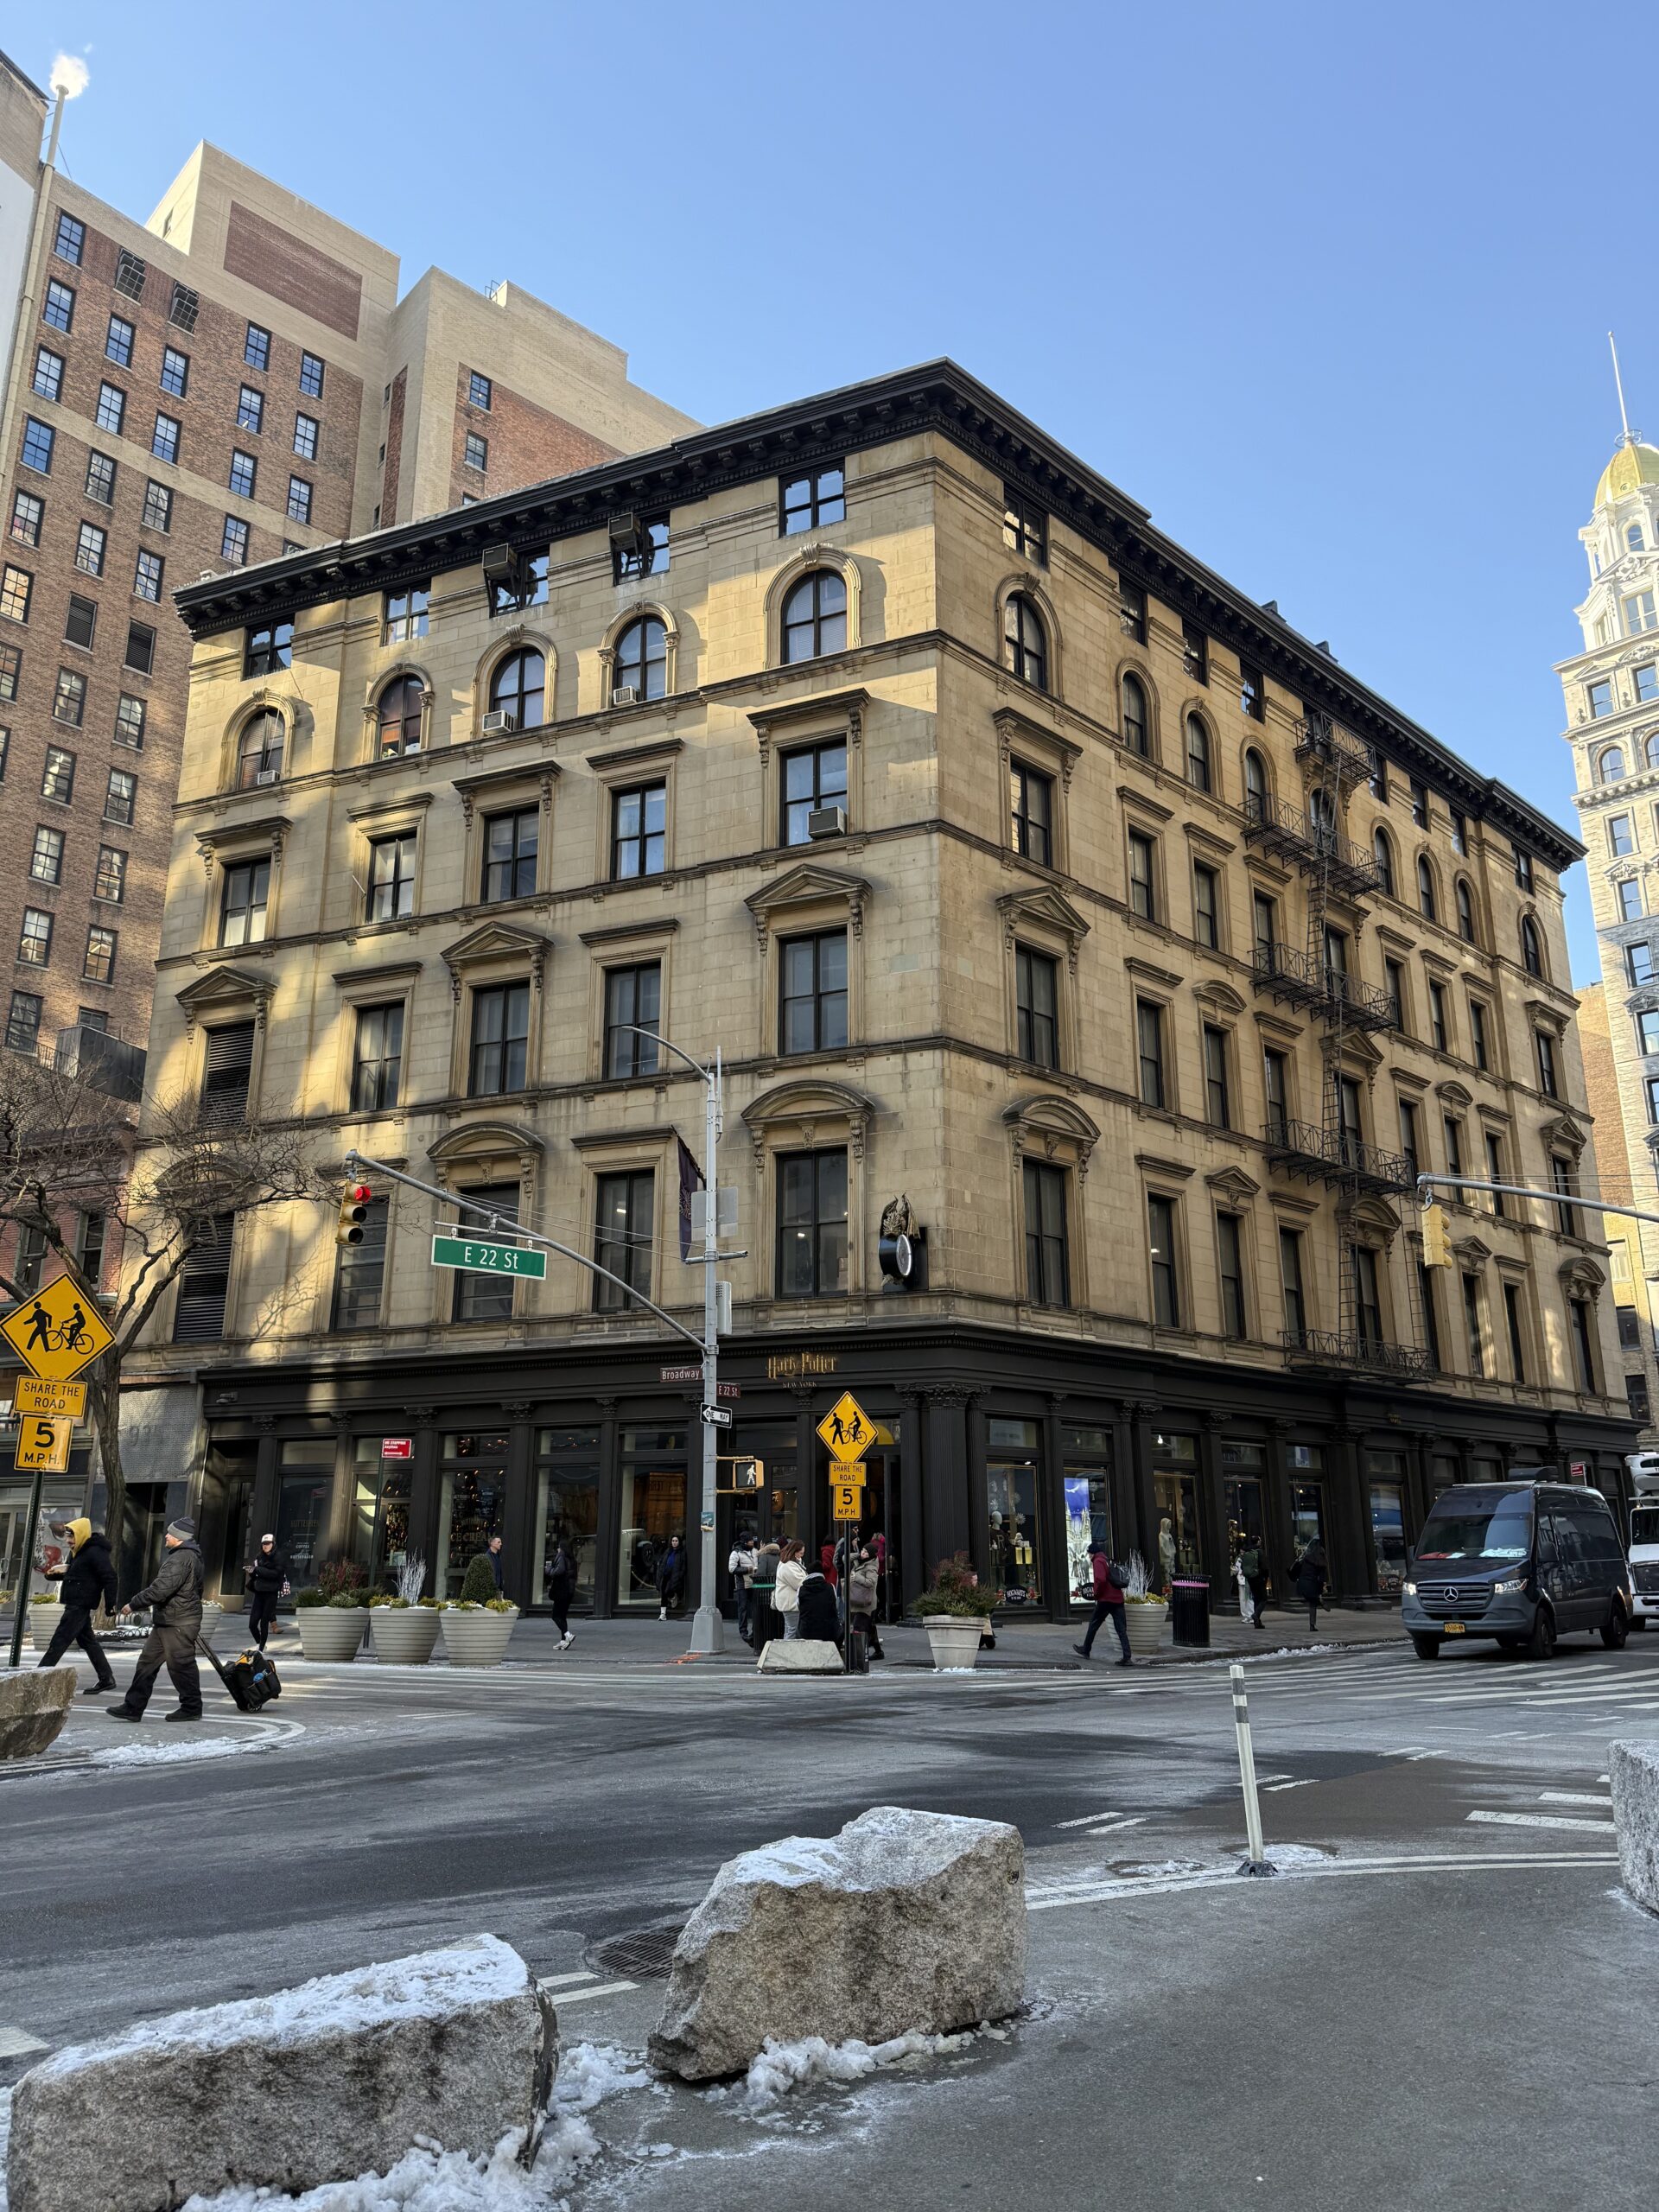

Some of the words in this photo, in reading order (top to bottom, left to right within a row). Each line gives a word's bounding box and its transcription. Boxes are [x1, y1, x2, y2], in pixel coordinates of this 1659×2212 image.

[465, 1246, 472, 1262] E
[480, 1249, 497, 1266] 22
[504, 1252, 518, 1269] St
[766, 1356, 796, 1381] Harry
[801, 1351, 836, 1382] Potter
[662, 1370, 700, 1380] Broadway
[24, 1382, 57, 1395] SHARE
[62, 1385, 79, 1397] THE
[719, 1385, 722, 1395] E
[724, 1386, 730, 1396] 22
[732, 1387, 738, 1396] St
[35, 1396, 66, 1409] ROAD
[706, 1410, 715, 1419] ONE
[720, 1413, 728, 1422] WAY
[35, 1421, 55, 1448] 5
[24, 1452, 60, 1465] M.P.H.
[842, 1488, 853, 1505] 5
